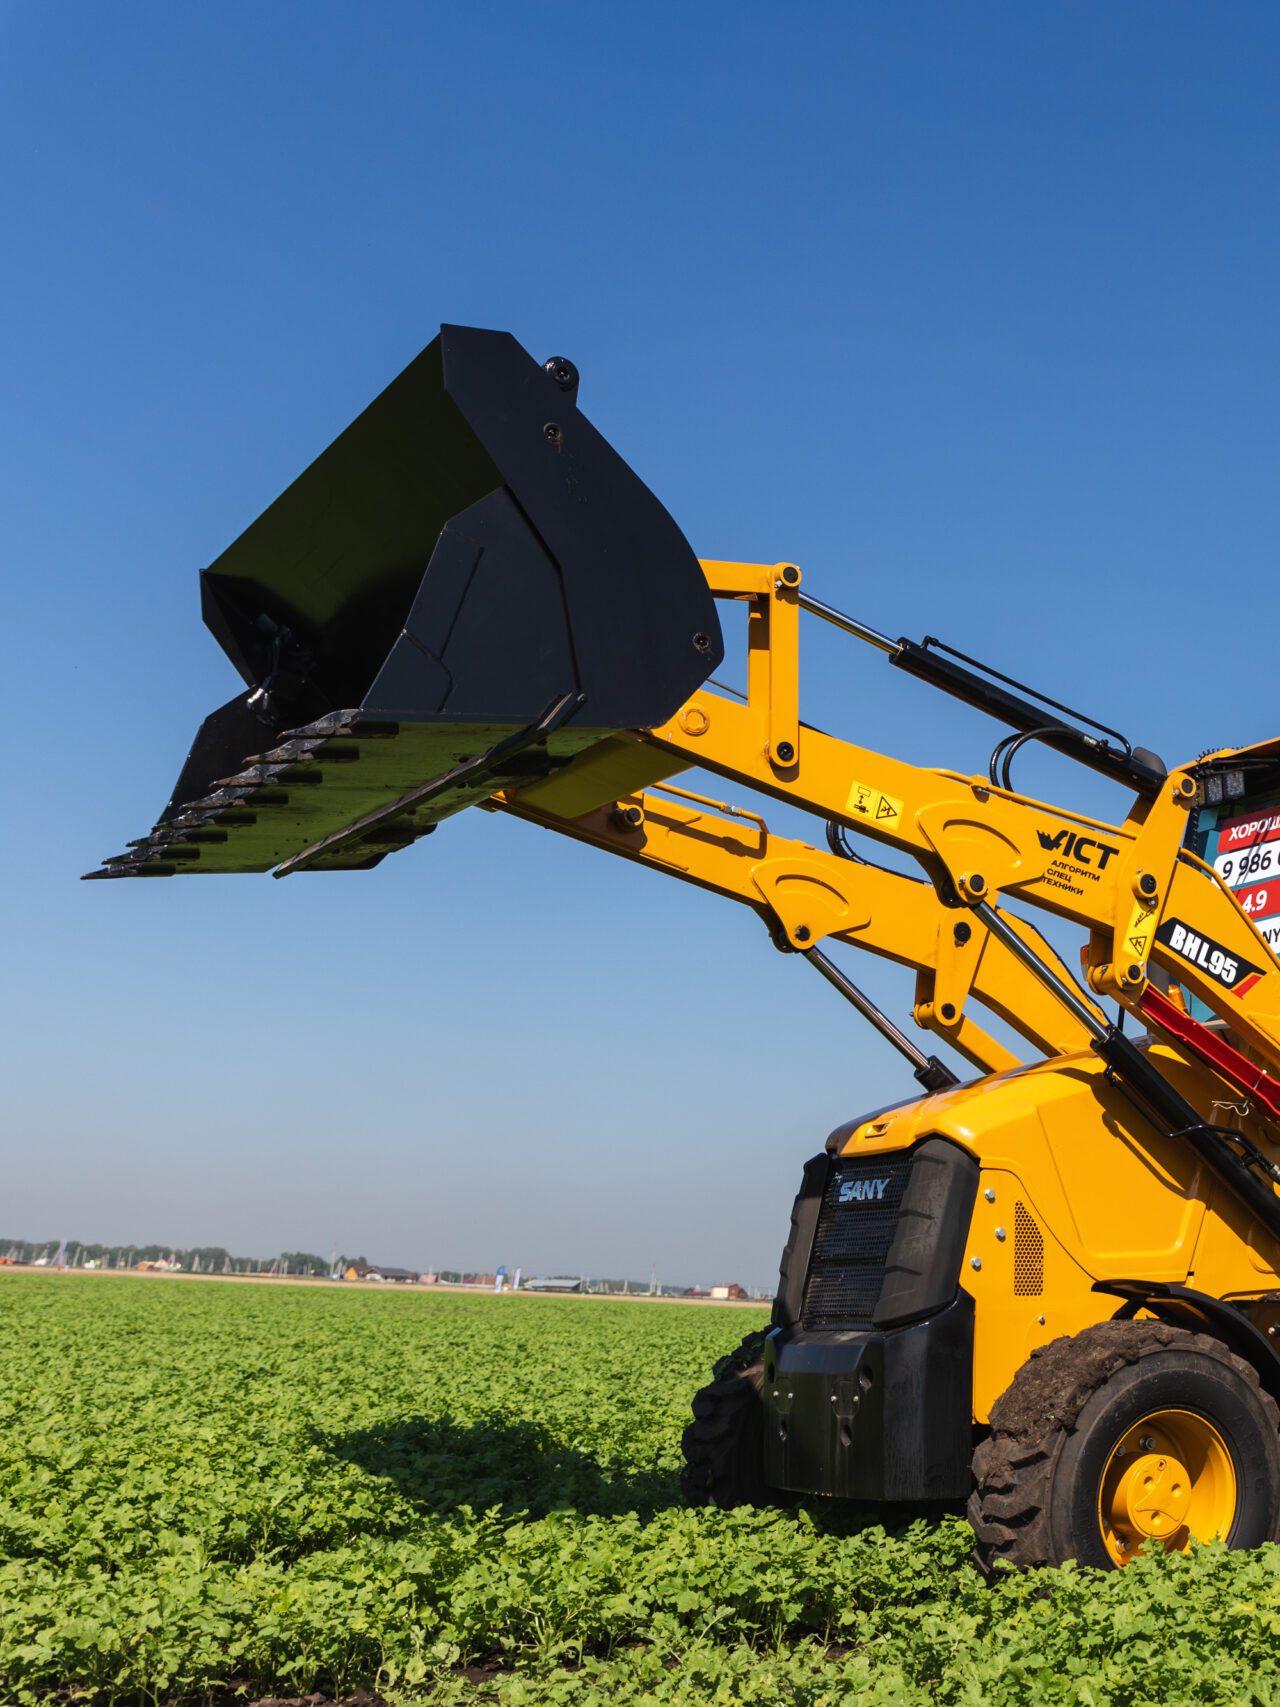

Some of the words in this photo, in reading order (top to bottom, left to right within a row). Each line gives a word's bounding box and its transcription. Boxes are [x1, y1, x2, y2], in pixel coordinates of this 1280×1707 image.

[1047, 868, 1072, 883] СПЕЦ
[1051, 860, 1101, 882] АЛГОРИТМ
[1222, 860, 1234, 880] 9
[1238, 850, 1272, 876] 986
[1041, 876, 1084, 896] ТЕХНИКИ
[1242, 889, 1268, 913] 4.9
[1169, 923, 1239, 984] BHL95
[838, 1178, 891, 1203] SANY
